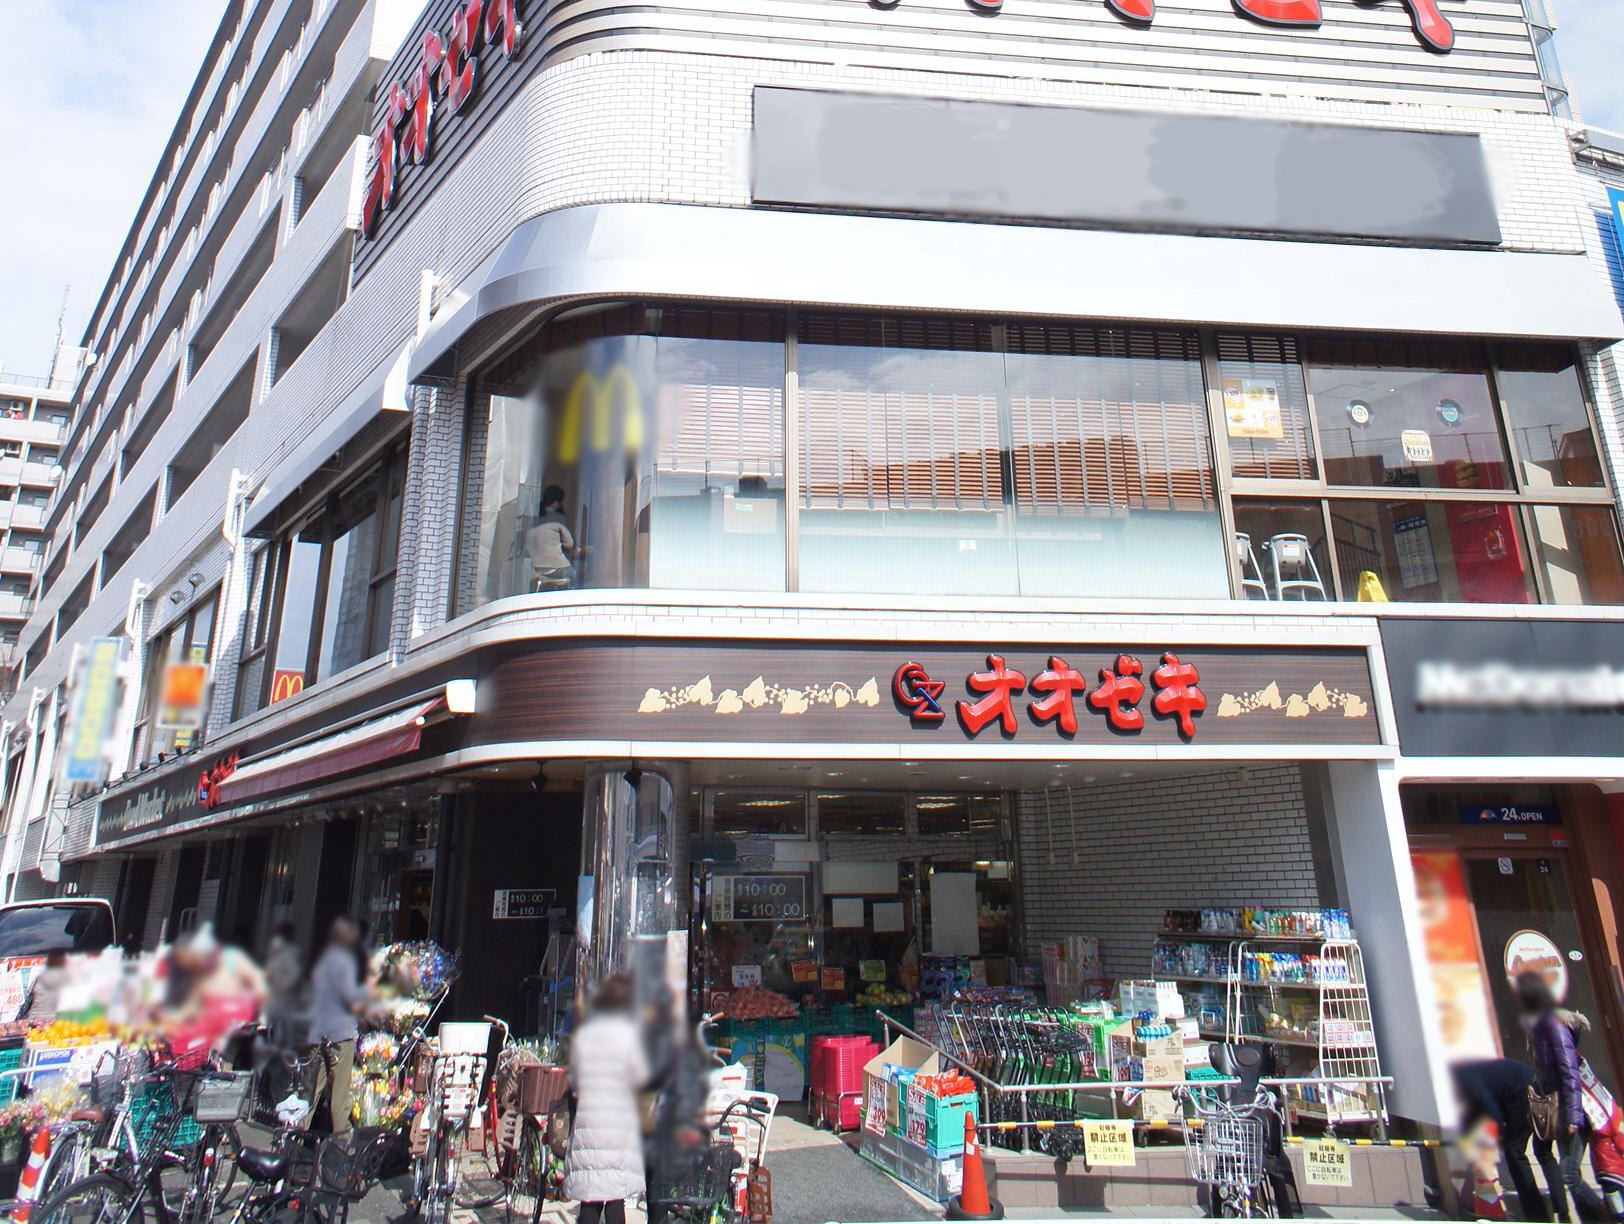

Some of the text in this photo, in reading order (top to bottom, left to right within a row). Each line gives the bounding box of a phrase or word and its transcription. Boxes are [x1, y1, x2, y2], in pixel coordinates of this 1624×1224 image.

[956, 652, 1207, 738] オオゼキ
[1090, 1132, 1127, 1143] 禁止区域
[1310, 1152, 1344, 1164] 禁止区域
